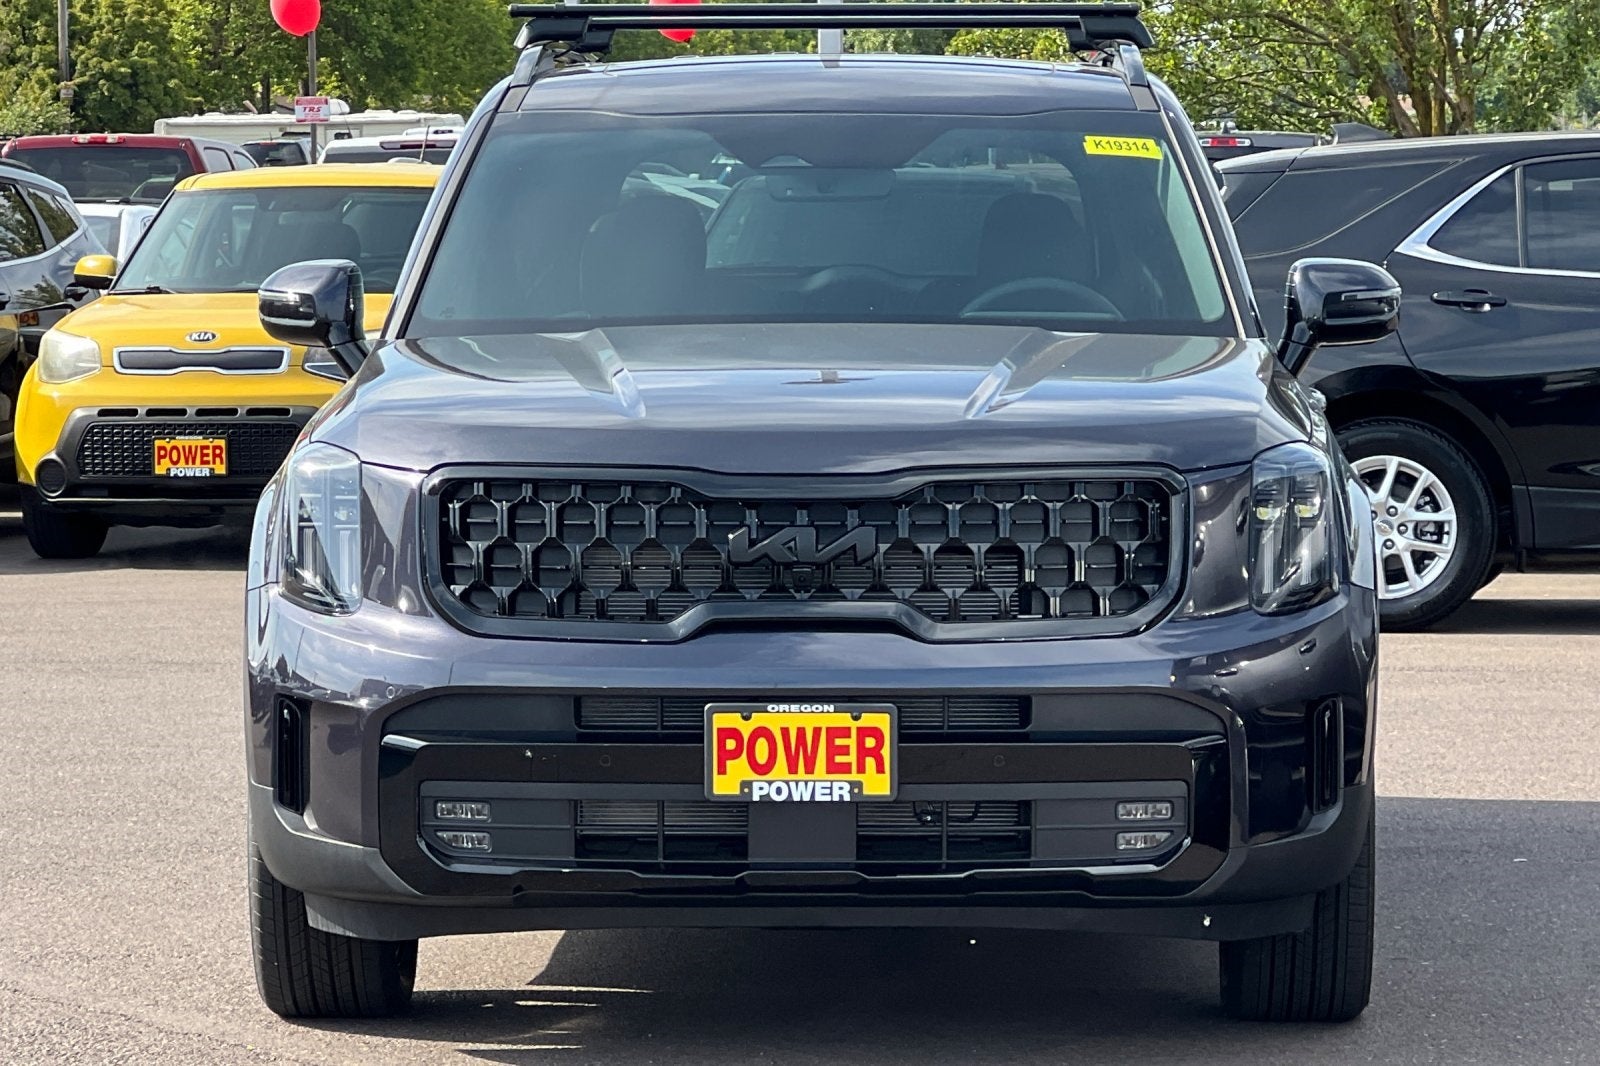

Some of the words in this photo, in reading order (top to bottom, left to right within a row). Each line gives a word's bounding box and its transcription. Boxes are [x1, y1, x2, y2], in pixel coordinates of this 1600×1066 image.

[1093, 139, 1149, 152] K19314
[191, 332, 213, 340] KIA
[156, 445, 224, 466] POWER
[170, 468, 210, 477] POWER
[767, 704, 835, 713] OREGON
[717, 726, 885, 776] POWER
[752, 781, 850, 801] POWER
